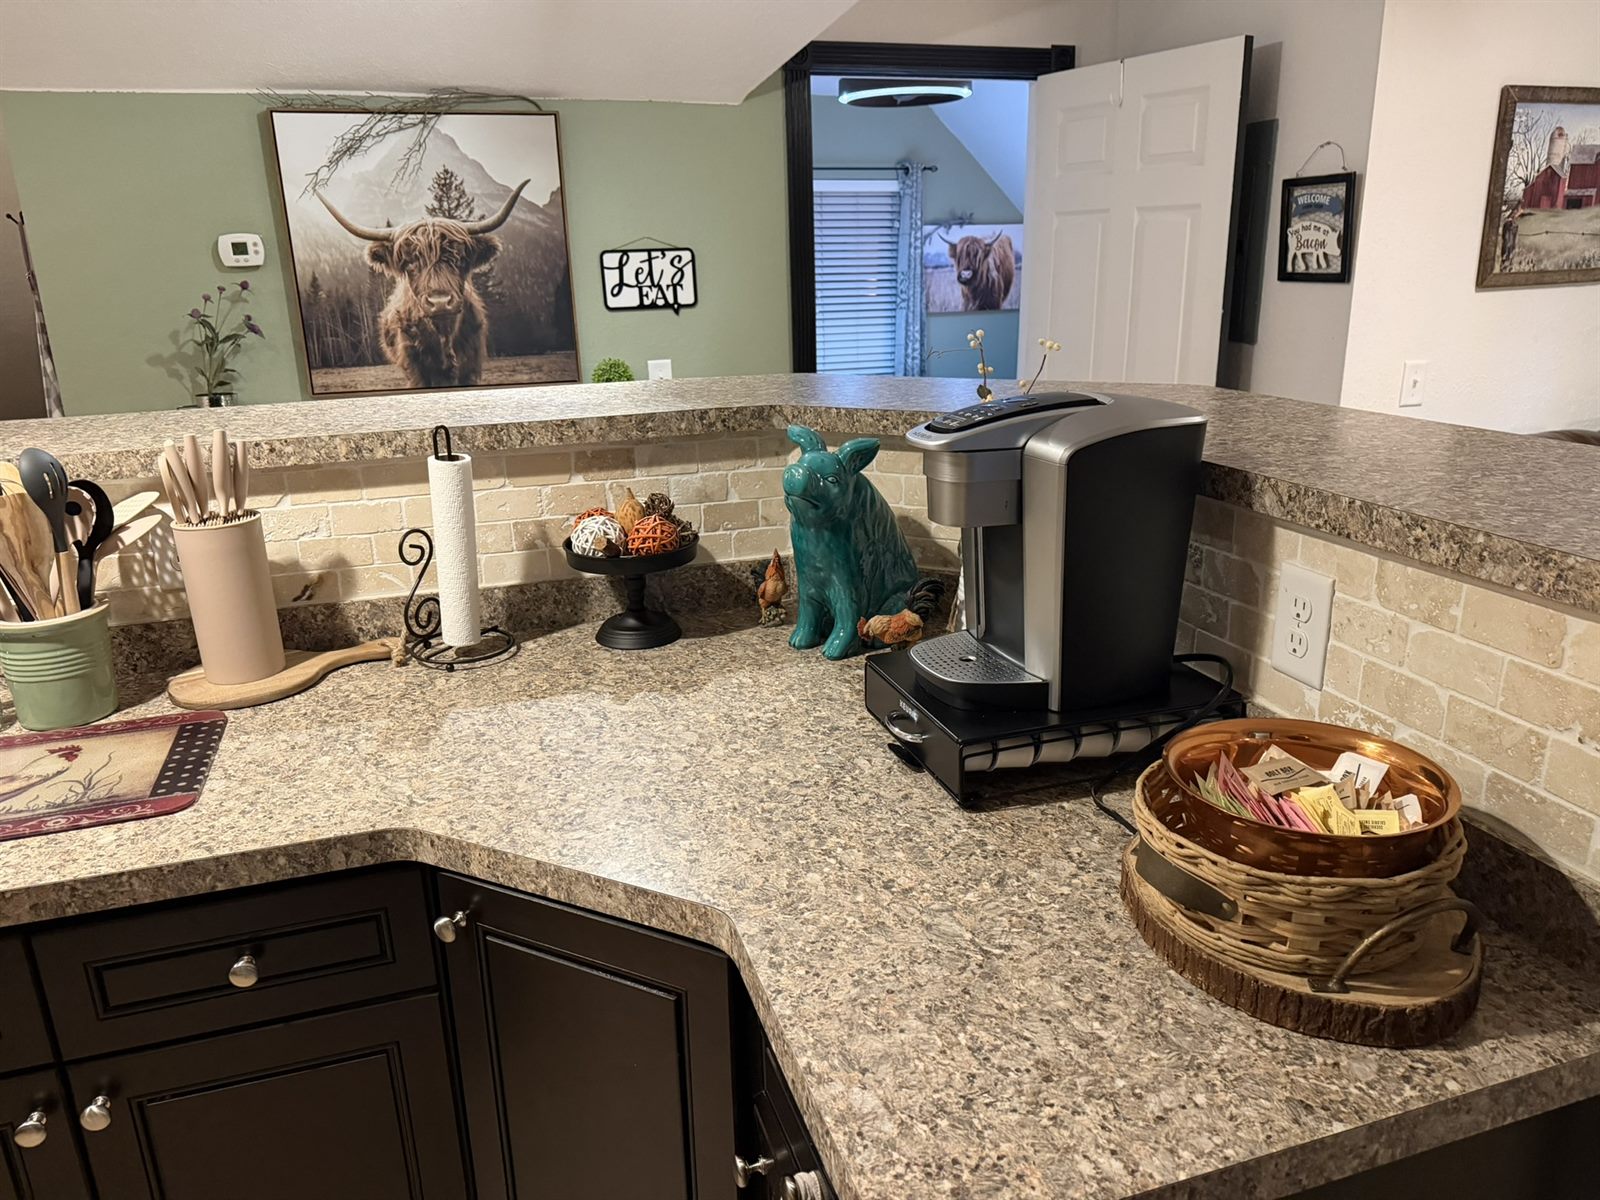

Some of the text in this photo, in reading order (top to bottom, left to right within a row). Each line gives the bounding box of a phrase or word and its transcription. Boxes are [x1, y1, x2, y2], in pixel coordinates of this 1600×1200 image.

[1297, 193, 1331, 205] WELCOME
[1288, 226, 1300, 237] You
[1301, 223, 1312, 231] had
[1322, 229, 1330, 237] at
[1295, 234, 1328, 251] Bacon
[604, 250, 692, 297] Let's
[637, 285, 684, 306] EAT
